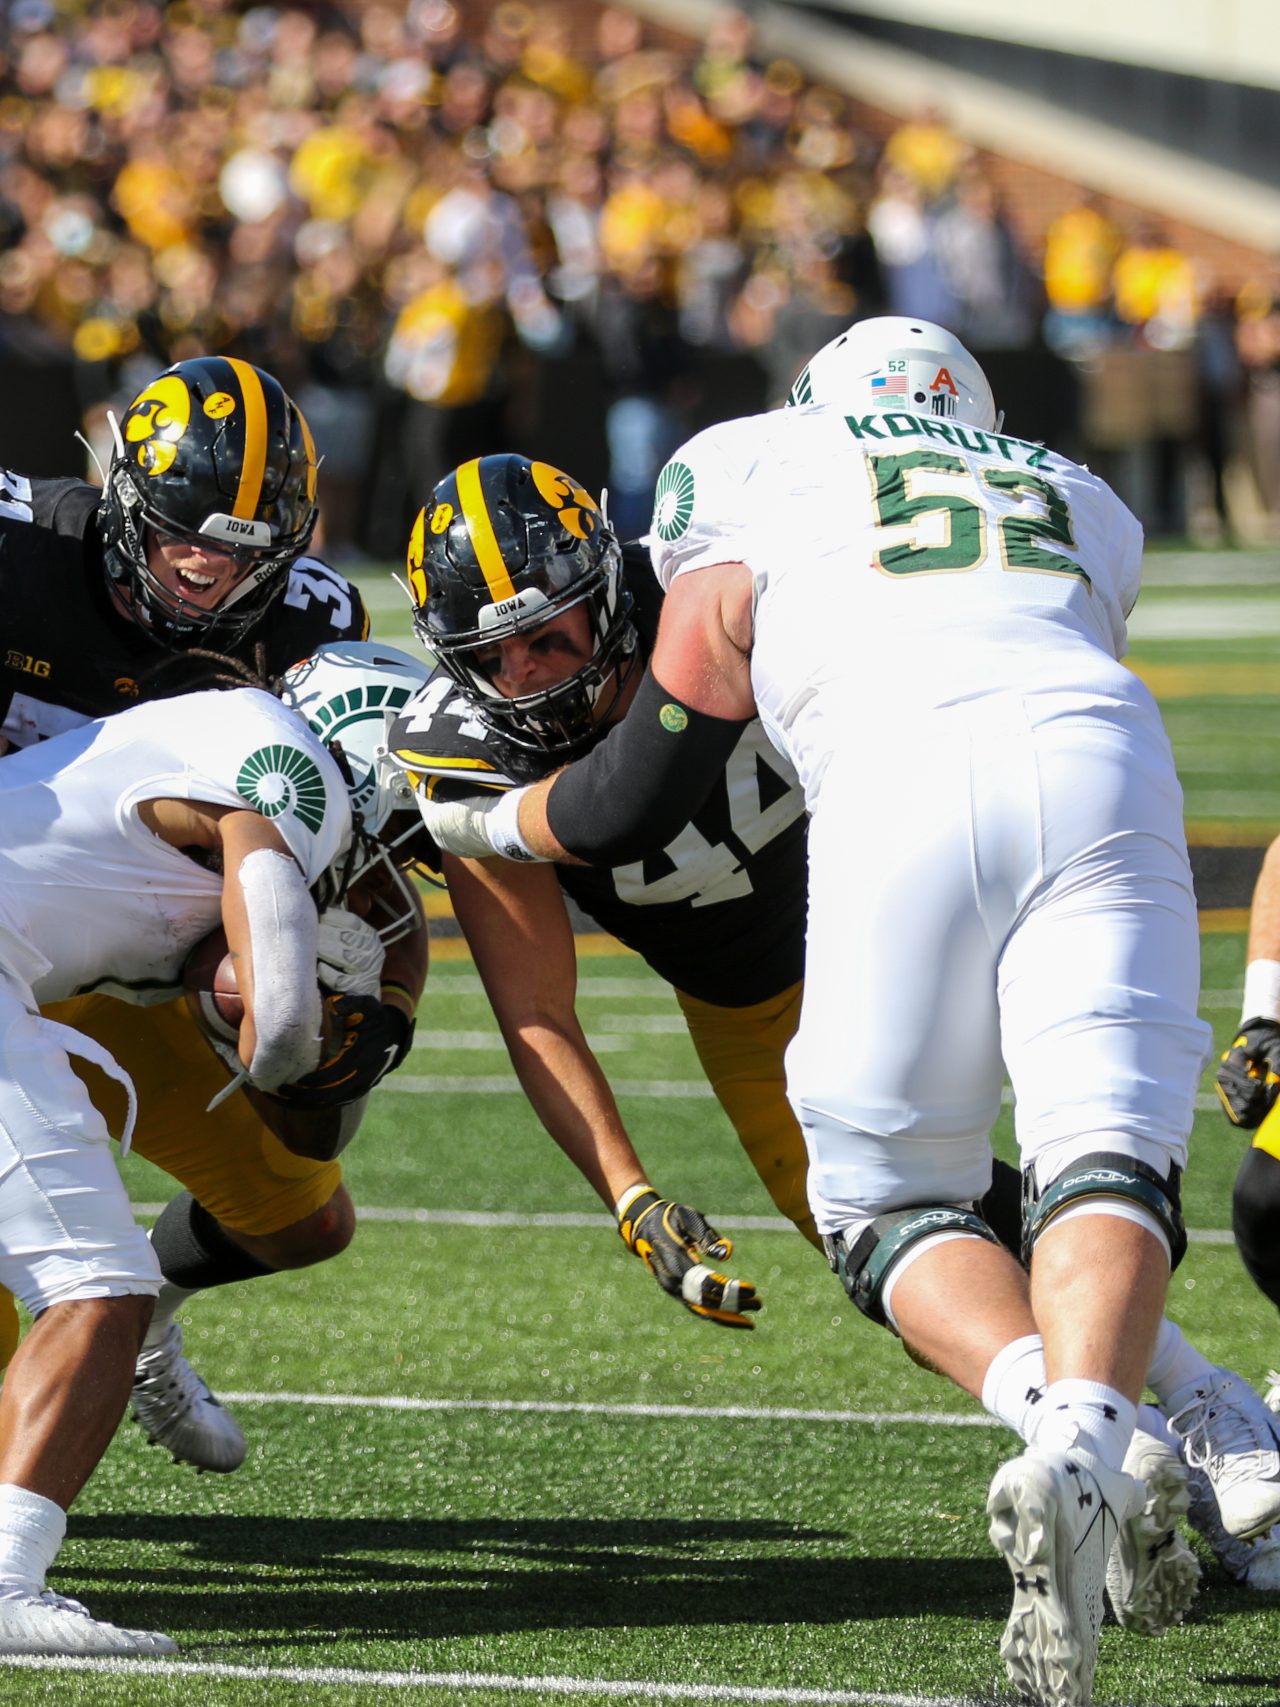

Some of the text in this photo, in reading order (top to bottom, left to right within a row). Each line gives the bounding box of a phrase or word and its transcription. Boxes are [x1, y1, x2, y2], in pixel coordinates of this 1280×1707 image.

[888, 361, 907, 373] 52
[843, 412, 1057, 473] KORUTZ
[225, 520, 255, 536] IOWA
[863, 446, 1094, 595] 52
[494, 598, 526, 617] IOWA
[397, 676, 490, 742] 44
